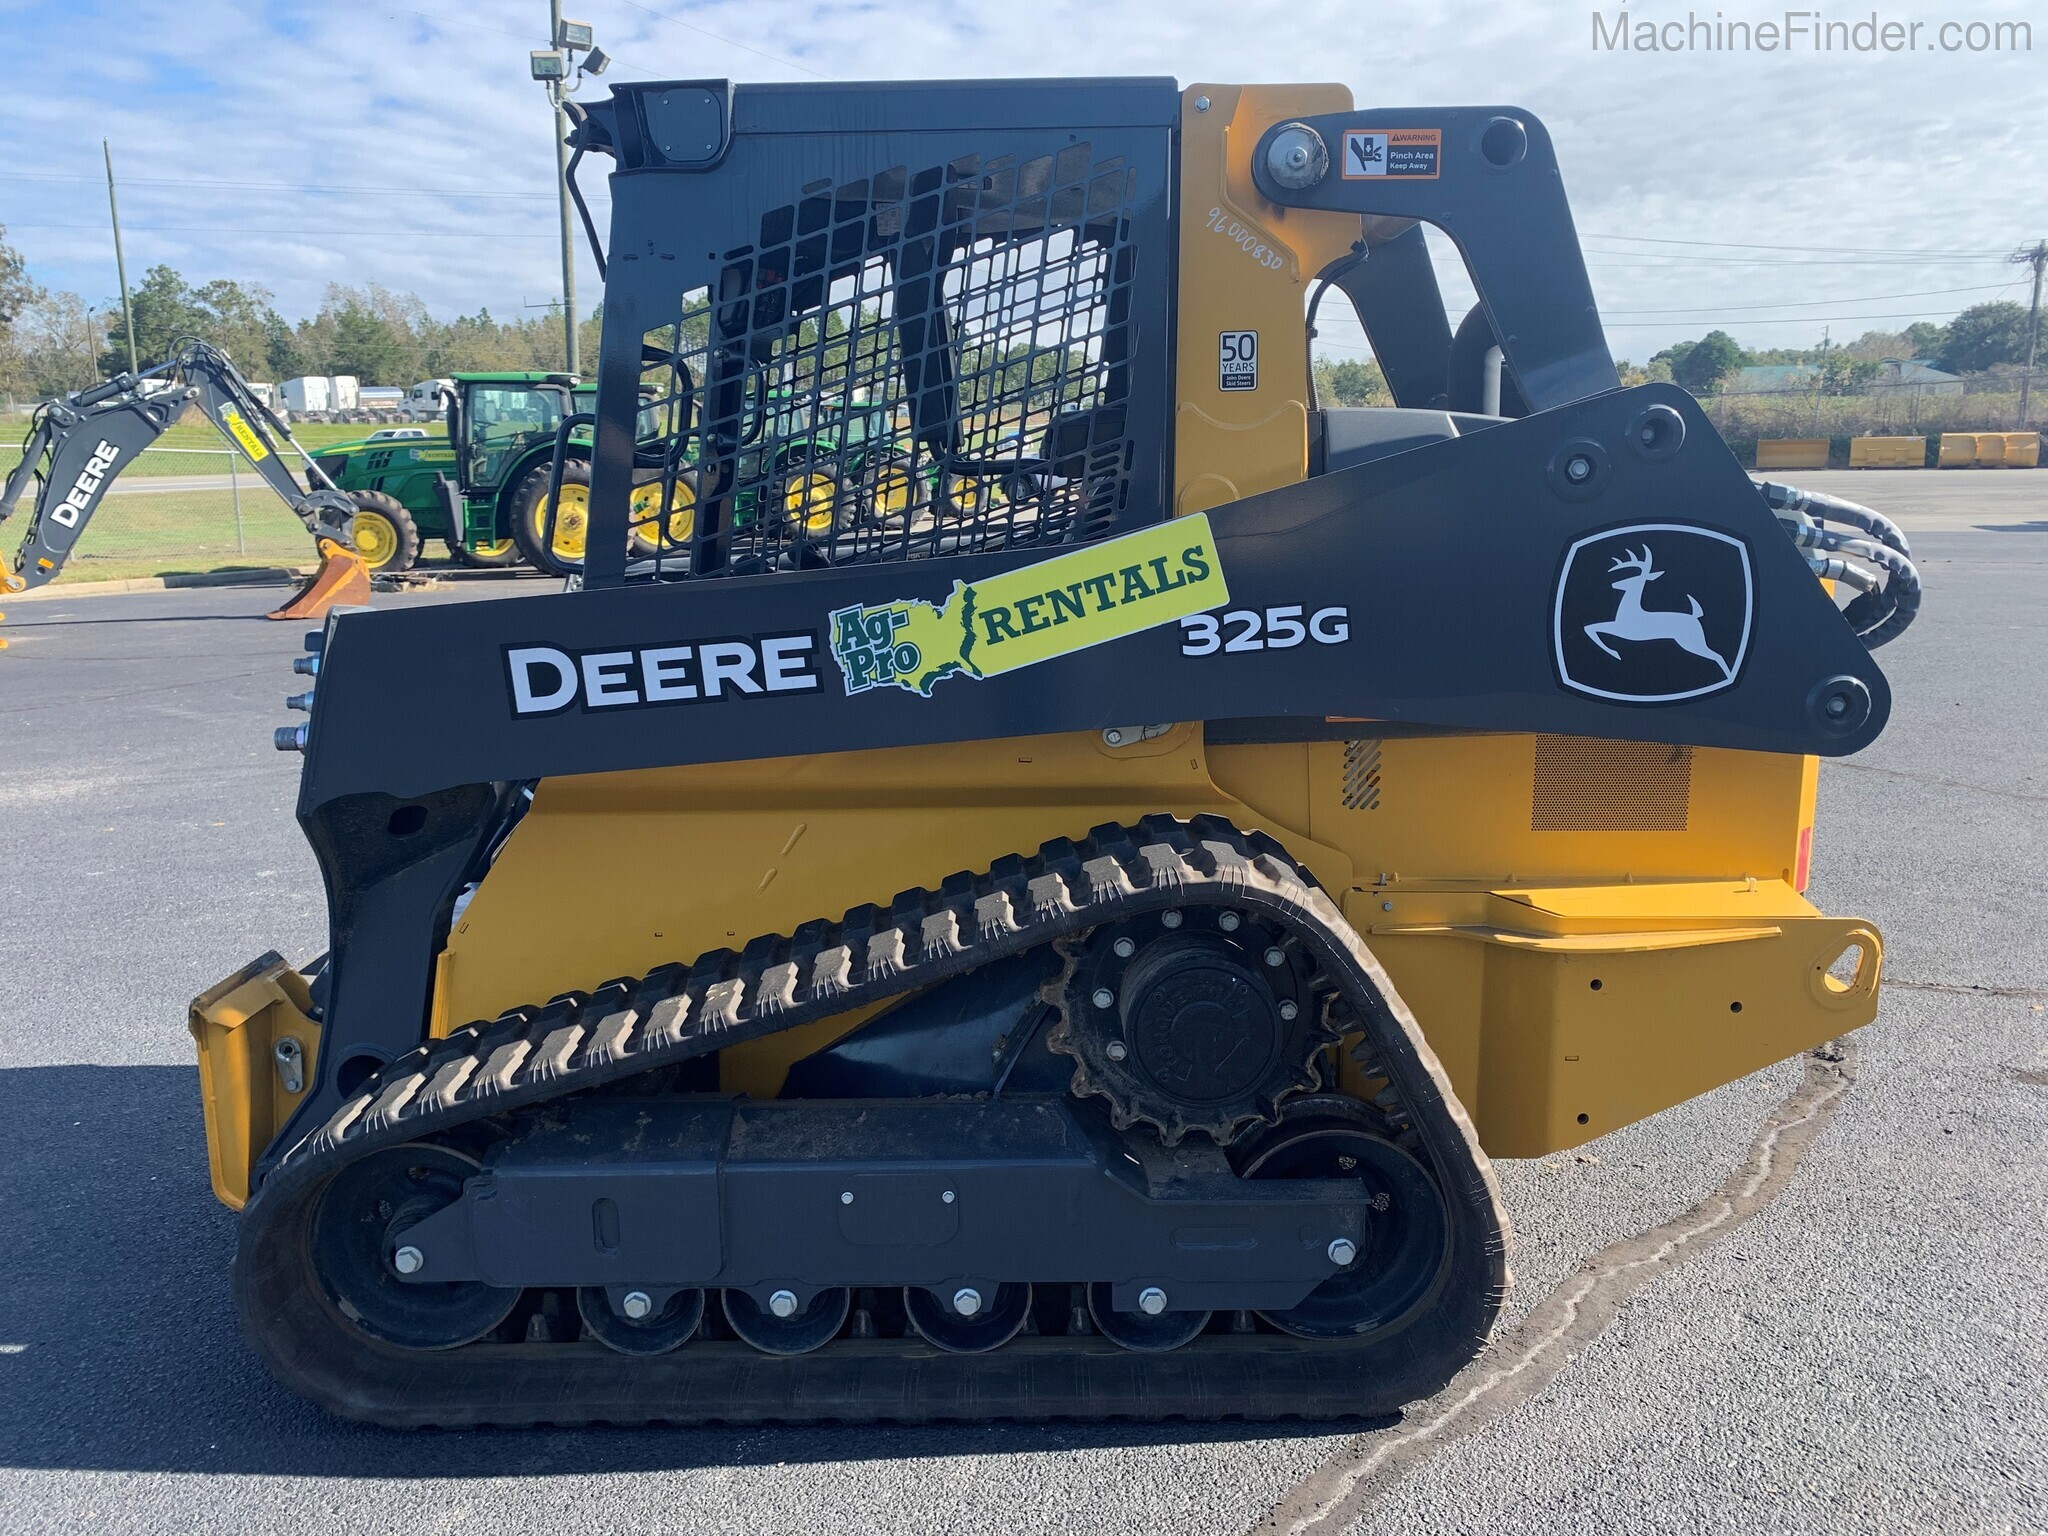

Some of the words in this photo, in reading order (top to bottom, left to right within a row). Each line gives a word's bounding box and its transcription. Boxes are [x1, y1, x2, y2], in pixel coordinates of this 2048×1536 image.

[1390, 151, 1413, 160] Pinch
[1415, 151, 1434, 160] Area
[1400, 134, 1437, 142] WARNING
[1390, 162, 1407, 170] Keep
[1408, 162, 1428, 170] Away
[1222, 334, 1255, 362] 50
[1222, 362, 1255, 373] YEARS
[50, 439, 120, 529] DEERE
[978, 545, 1211, 646] RENTALS
[838, 608, 908, 655] Ag-
[1180, 605, 1349, 657] 325G
[508, 635, 817, 713] DEERE
[844, 643, 921, 691] Pro
